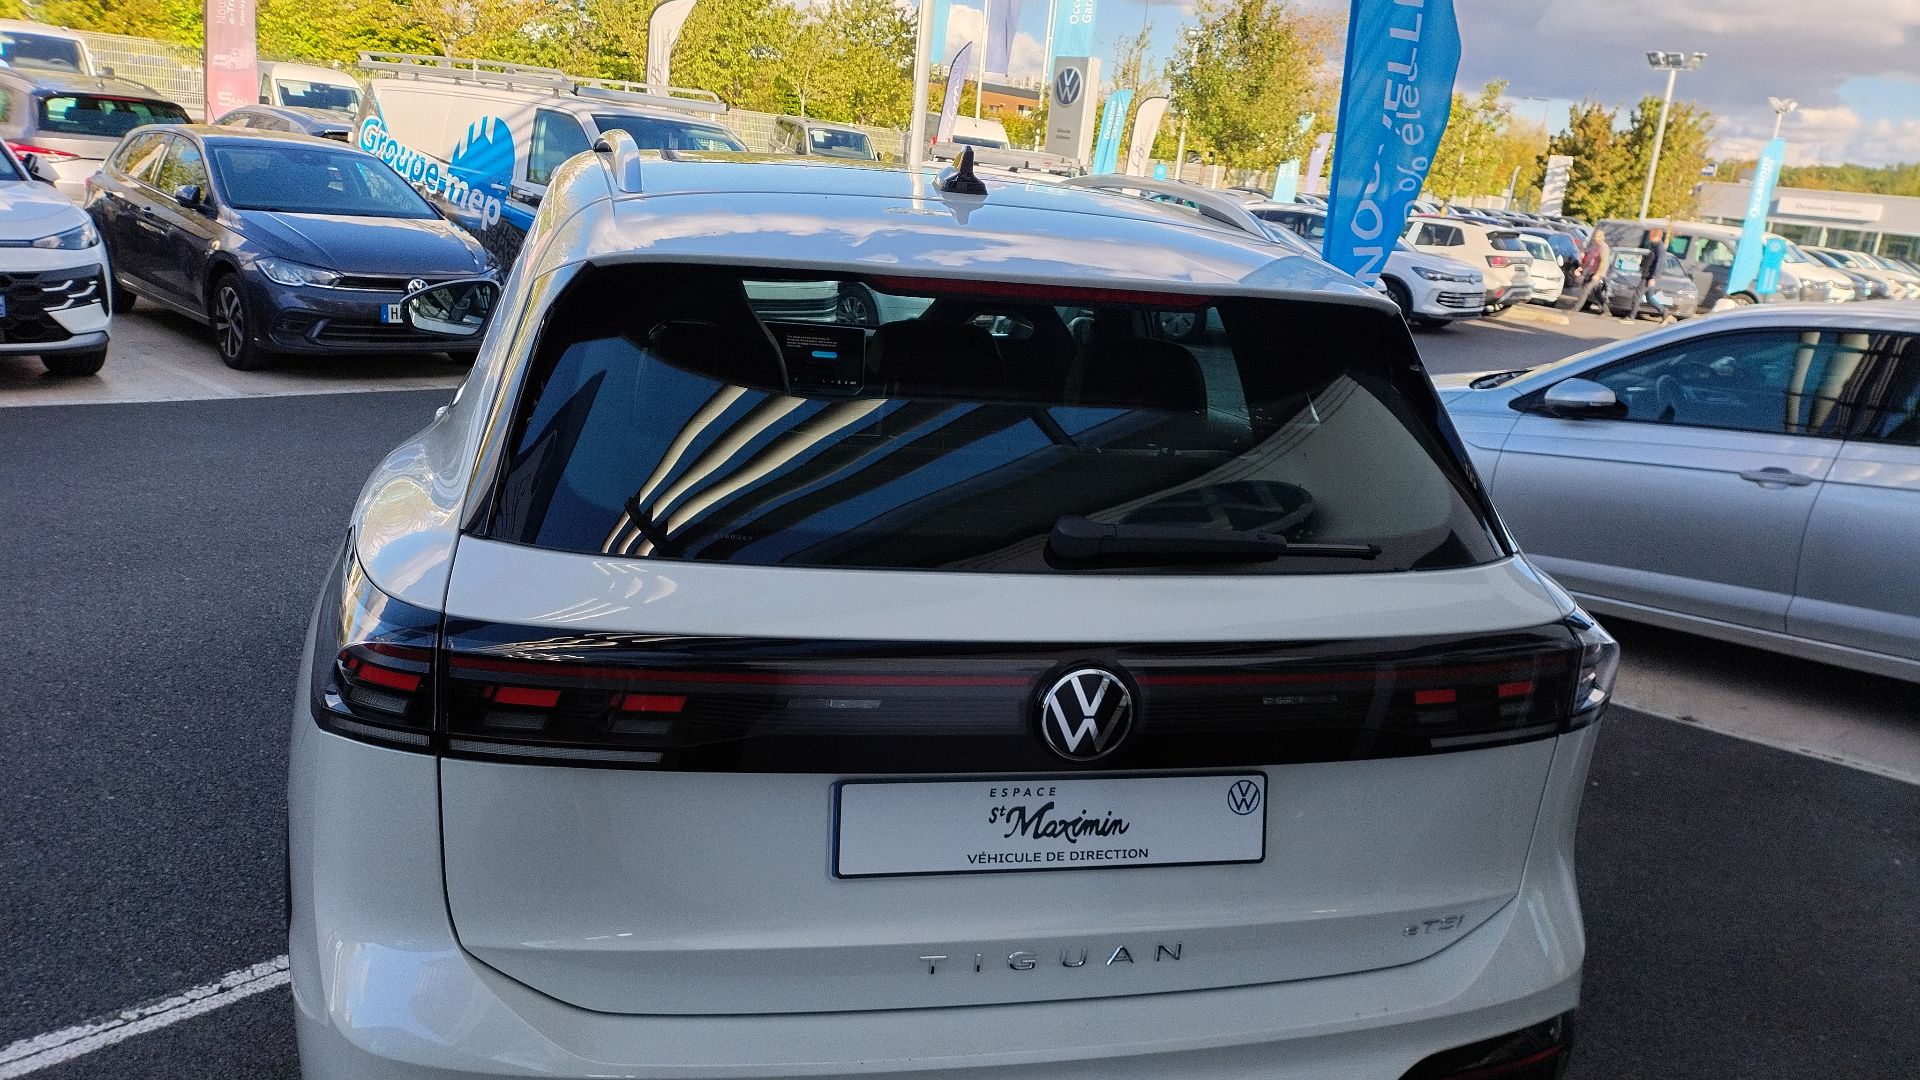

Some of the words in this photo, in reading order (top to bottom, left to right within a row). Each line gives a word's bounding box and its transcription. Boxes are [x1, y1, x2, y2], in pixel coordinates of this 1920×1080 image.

[216, 0, 227, 24] Nou
[1069, 0, 1080, 24] Occ
[1103, 100, 1117, 140] Occasions
[1042, 668, 1132, 761] VW
[989, 787, 1057, 798] ESPACE
[1004, 801, 1130, 844] Maximin
[967, 852, 1042, 864] VÉHICULE
[1046, 851, 1065, 862] DE
[1069, 848, 1149, 861] DIRECTION
[919, 942, 1183, 976] TIGUAN
